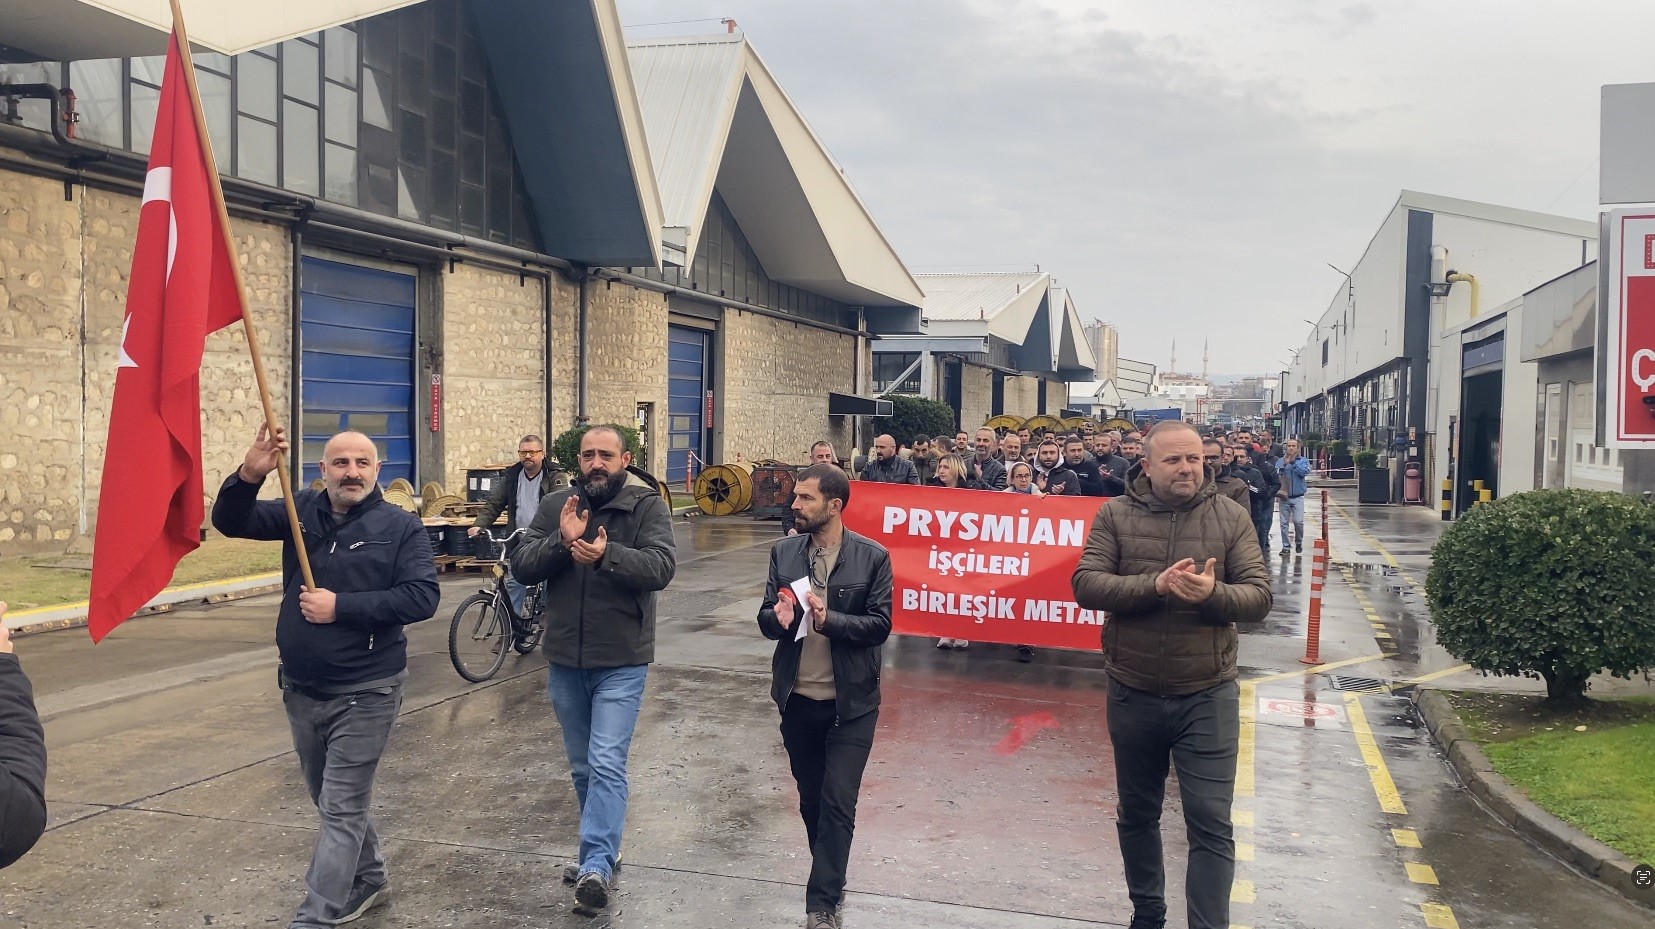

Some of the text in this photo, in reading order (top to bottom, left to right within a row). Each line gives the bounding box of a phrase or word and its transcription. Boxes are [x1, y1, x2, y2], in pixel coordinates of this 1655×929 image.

[882, 506, 1084, 547] PRYSMİAN
[928, 545, 1030, 577] İŞÇİLERİ
[902, 584, 1016, 624] BİRLEŞİK
